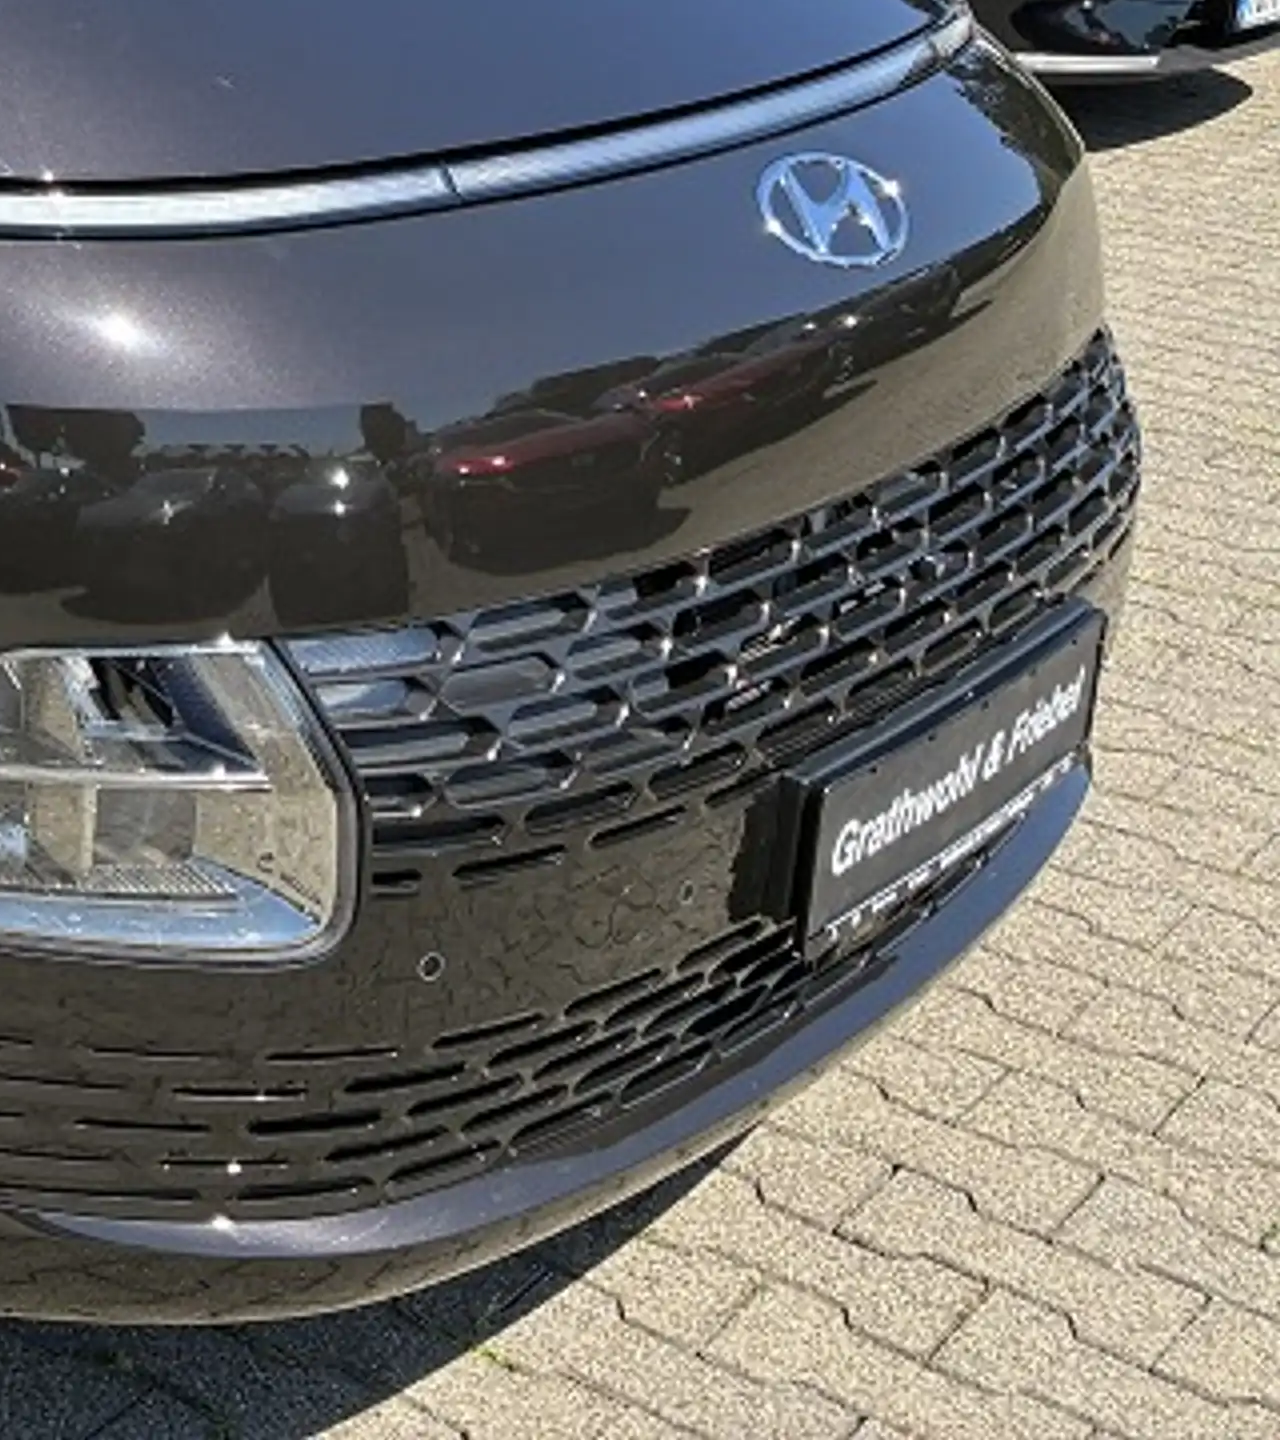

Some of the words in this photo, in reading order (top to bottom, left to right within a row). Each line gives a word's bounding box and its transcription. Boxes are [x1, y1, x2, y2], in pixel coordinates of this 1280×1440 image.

[831, 743, 985, 876] Grathwohl
[981, 728, 1007, 782] &
[1005, 663, 1086, 765] Friebel
